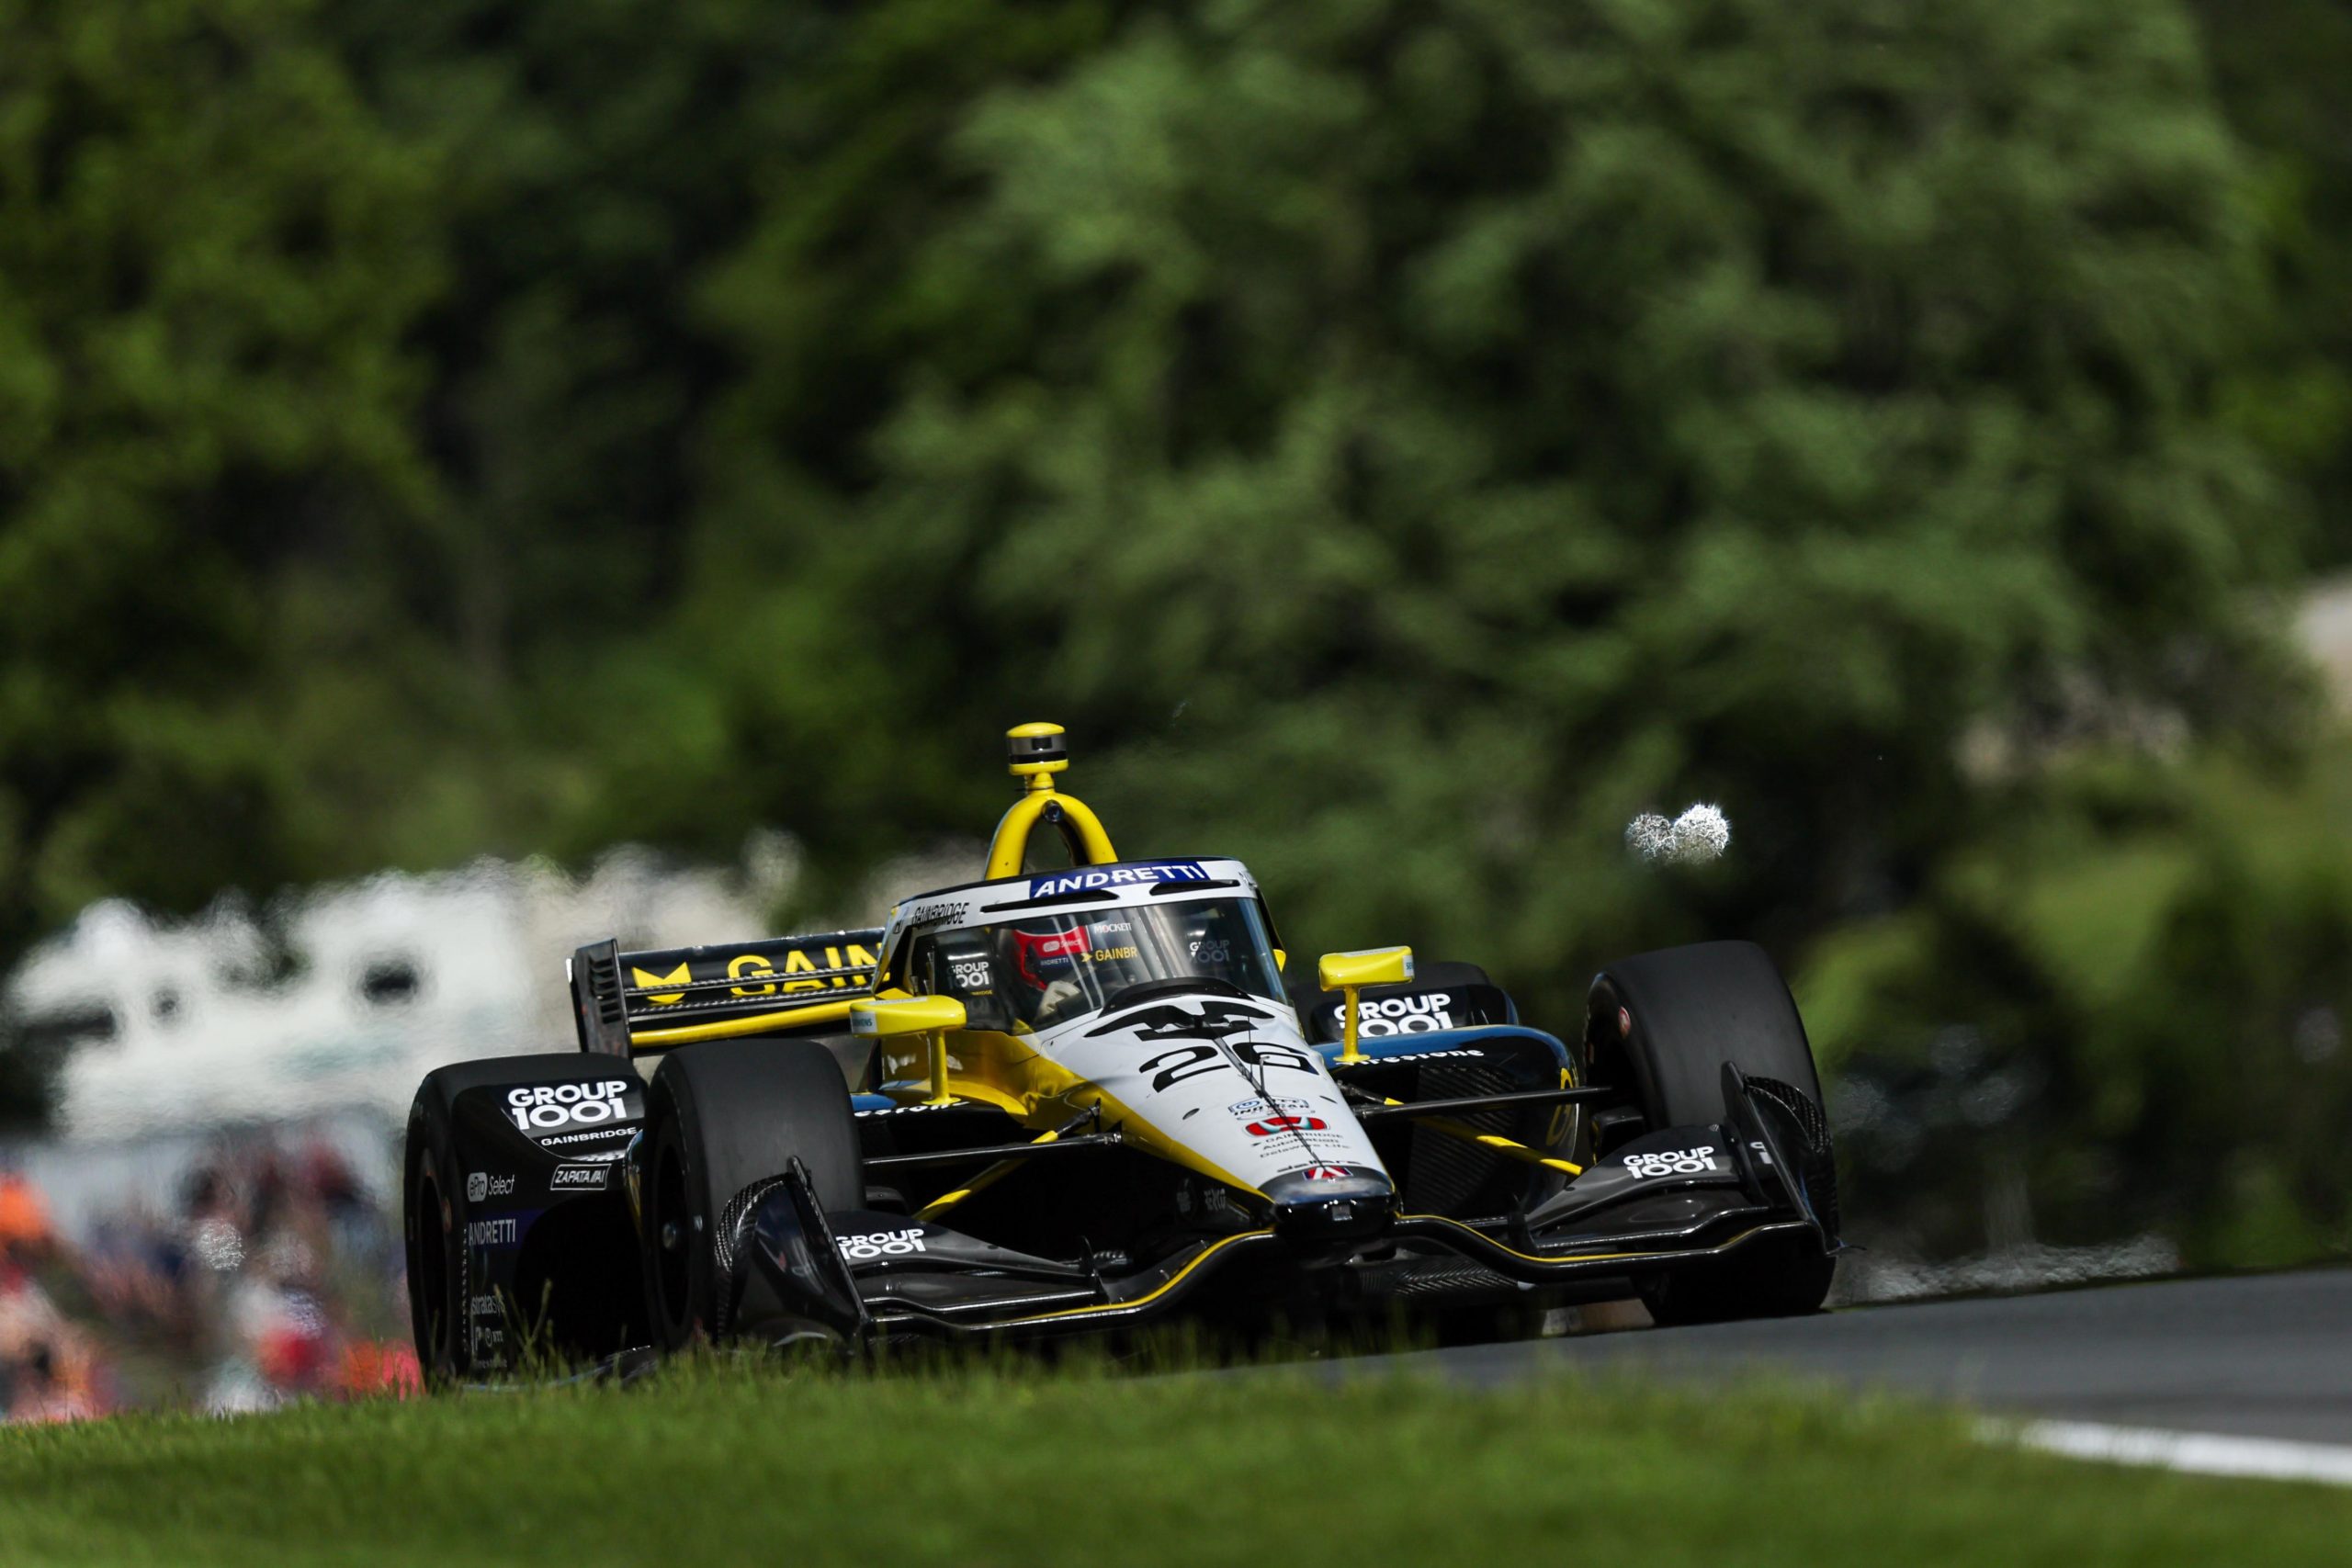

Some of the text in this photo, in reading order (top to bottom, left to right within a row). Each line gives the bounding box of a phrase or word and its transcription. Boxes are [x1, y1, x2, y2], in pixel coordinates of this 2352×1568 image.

[1033, 863, 1204, 898] ANDRETTI
[1339, 1011, 1453, 1038] 001
[1139, 1043, 1319, 1093] 26
[508, 1080, 628, 1108] GROUP
[511, 1098, 628, 1131] 1001
[541, 1126, 638, 1146] GAINBRIDGE
[1623, 1145, 1715, 1167] GROUP
[1627, 1156, 1717, 1179] 1001
[488, 1174, 514, 1196] Select
[469, 1219, 516, 1246] ANDRETTI
[835, 1228, 924, 1247] GROUP
[839, 1238, 927, 1260] 1001
